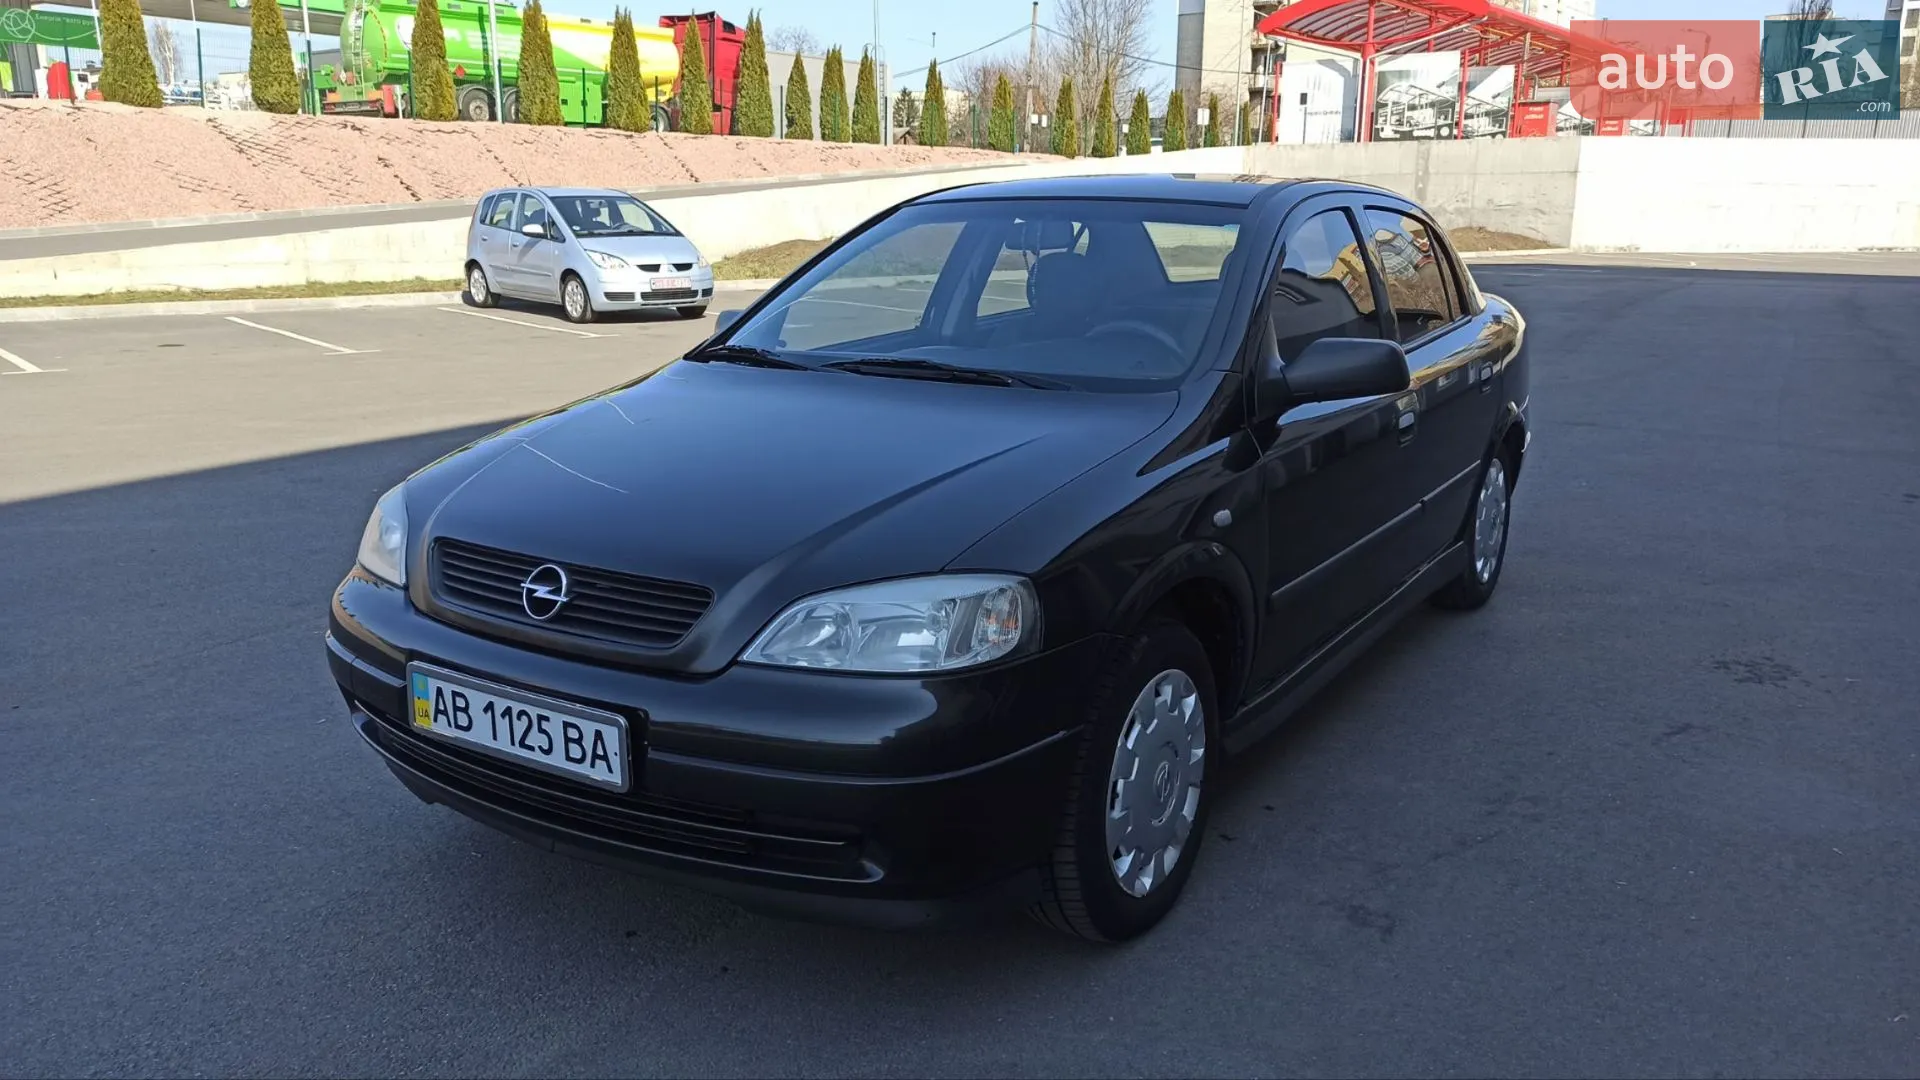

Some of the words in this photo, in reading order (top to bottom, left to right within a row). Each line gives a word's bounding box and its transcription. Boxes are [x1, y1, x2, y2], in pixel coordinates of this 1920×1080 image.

[417, 708, 430, 719] UA
[433, 685, 473, 732] AB
[482, 700, 554, 756] 1125
[562, 720, 614, 774] BA
